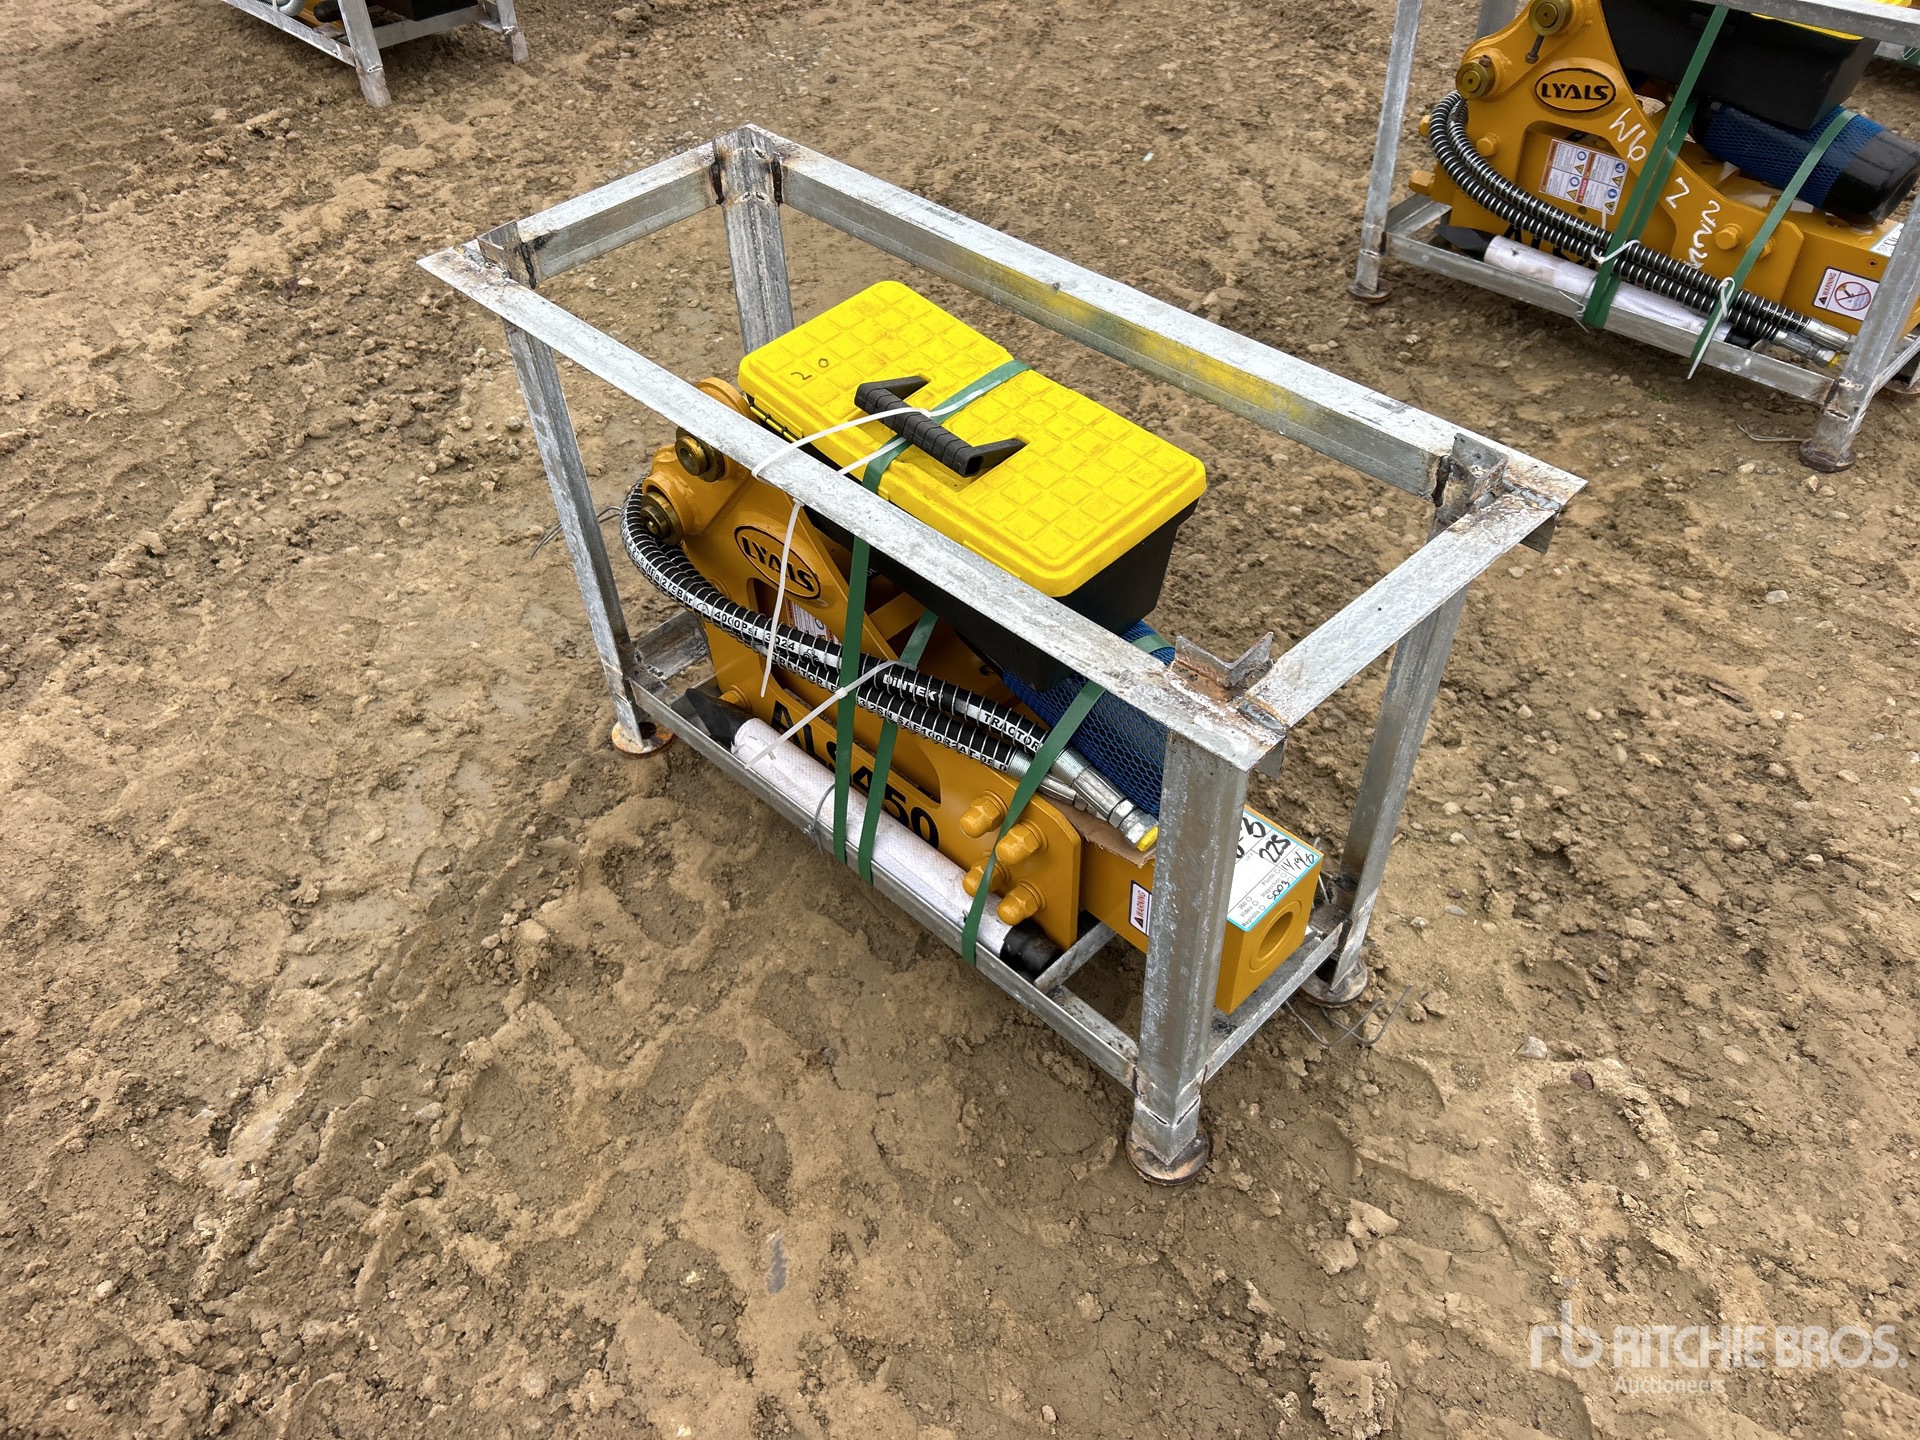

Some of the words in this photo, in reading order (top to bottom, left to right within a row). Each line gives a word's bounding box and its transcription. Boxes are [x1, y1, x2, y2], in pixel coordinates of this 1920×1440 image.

[1541, 83, 1609, 100] LYALS
[1822, 272, 1837, 296] WARNING
[741, 536, 814, 592] LYALS
[984, 713, 1039, 750] TRACTOR
[1260, 877, 1284, 898] Inspection
[1240, 905, 1253, 918] Video
